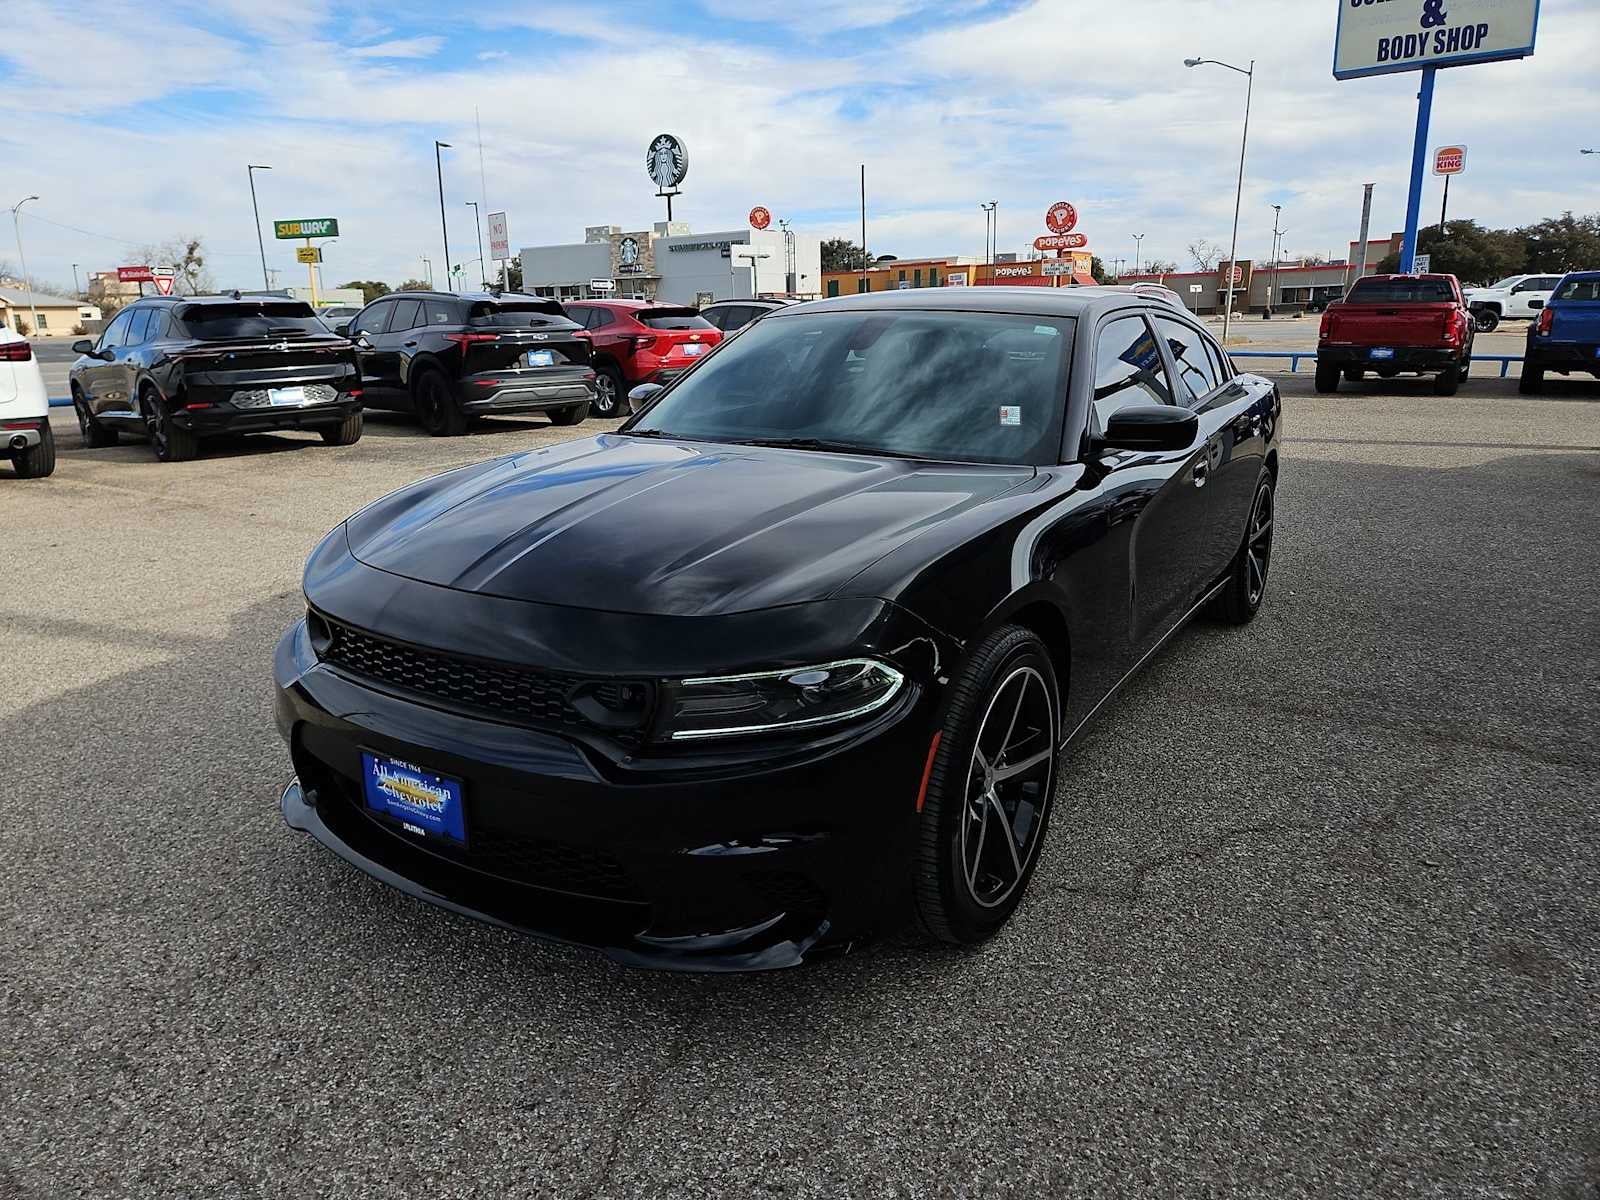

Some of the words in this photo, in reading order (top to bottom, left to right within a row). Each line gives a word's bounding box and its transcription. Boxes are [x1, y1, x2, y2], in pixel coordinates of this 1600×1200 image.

[1420, 0, 1447, 28] &
[1377, 32, 1430, 62] BODY
[1433, 23, 1488, 54] SHOP
[1436, 161, 1461, 169] KING
[278, 221, 331, 236] SUBWAY
[493, 223, 503, 235] NO
[1038, 234, 1082, 248] POPEYES
[995, 266, 1033, 276] POPEYES
[389, 757, 407, 769] SINCE
[372, 763, 388, 778] All
[392, 771, 451, 800] American
[383, 783, 444, 813] Chevrolet
